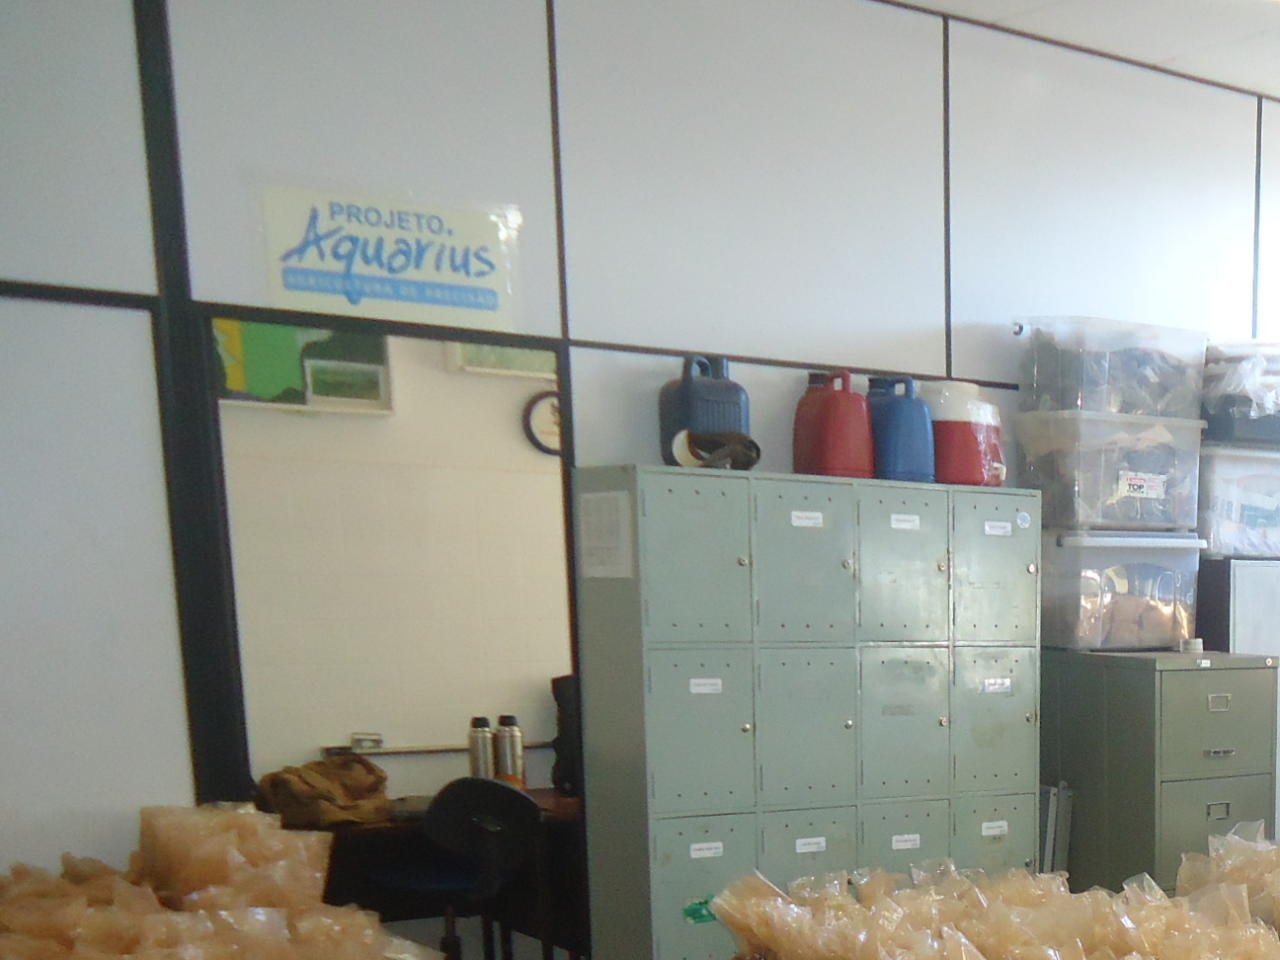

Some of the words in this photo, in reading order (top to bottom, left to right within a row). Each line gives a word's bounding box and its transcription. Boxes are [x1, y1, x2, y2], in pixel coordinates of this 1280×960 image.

[328, 201, 444, 235] PROJETO
[280, 206, 496, 305] Aquarius
[1127, 483, 1145, 492] TOP
